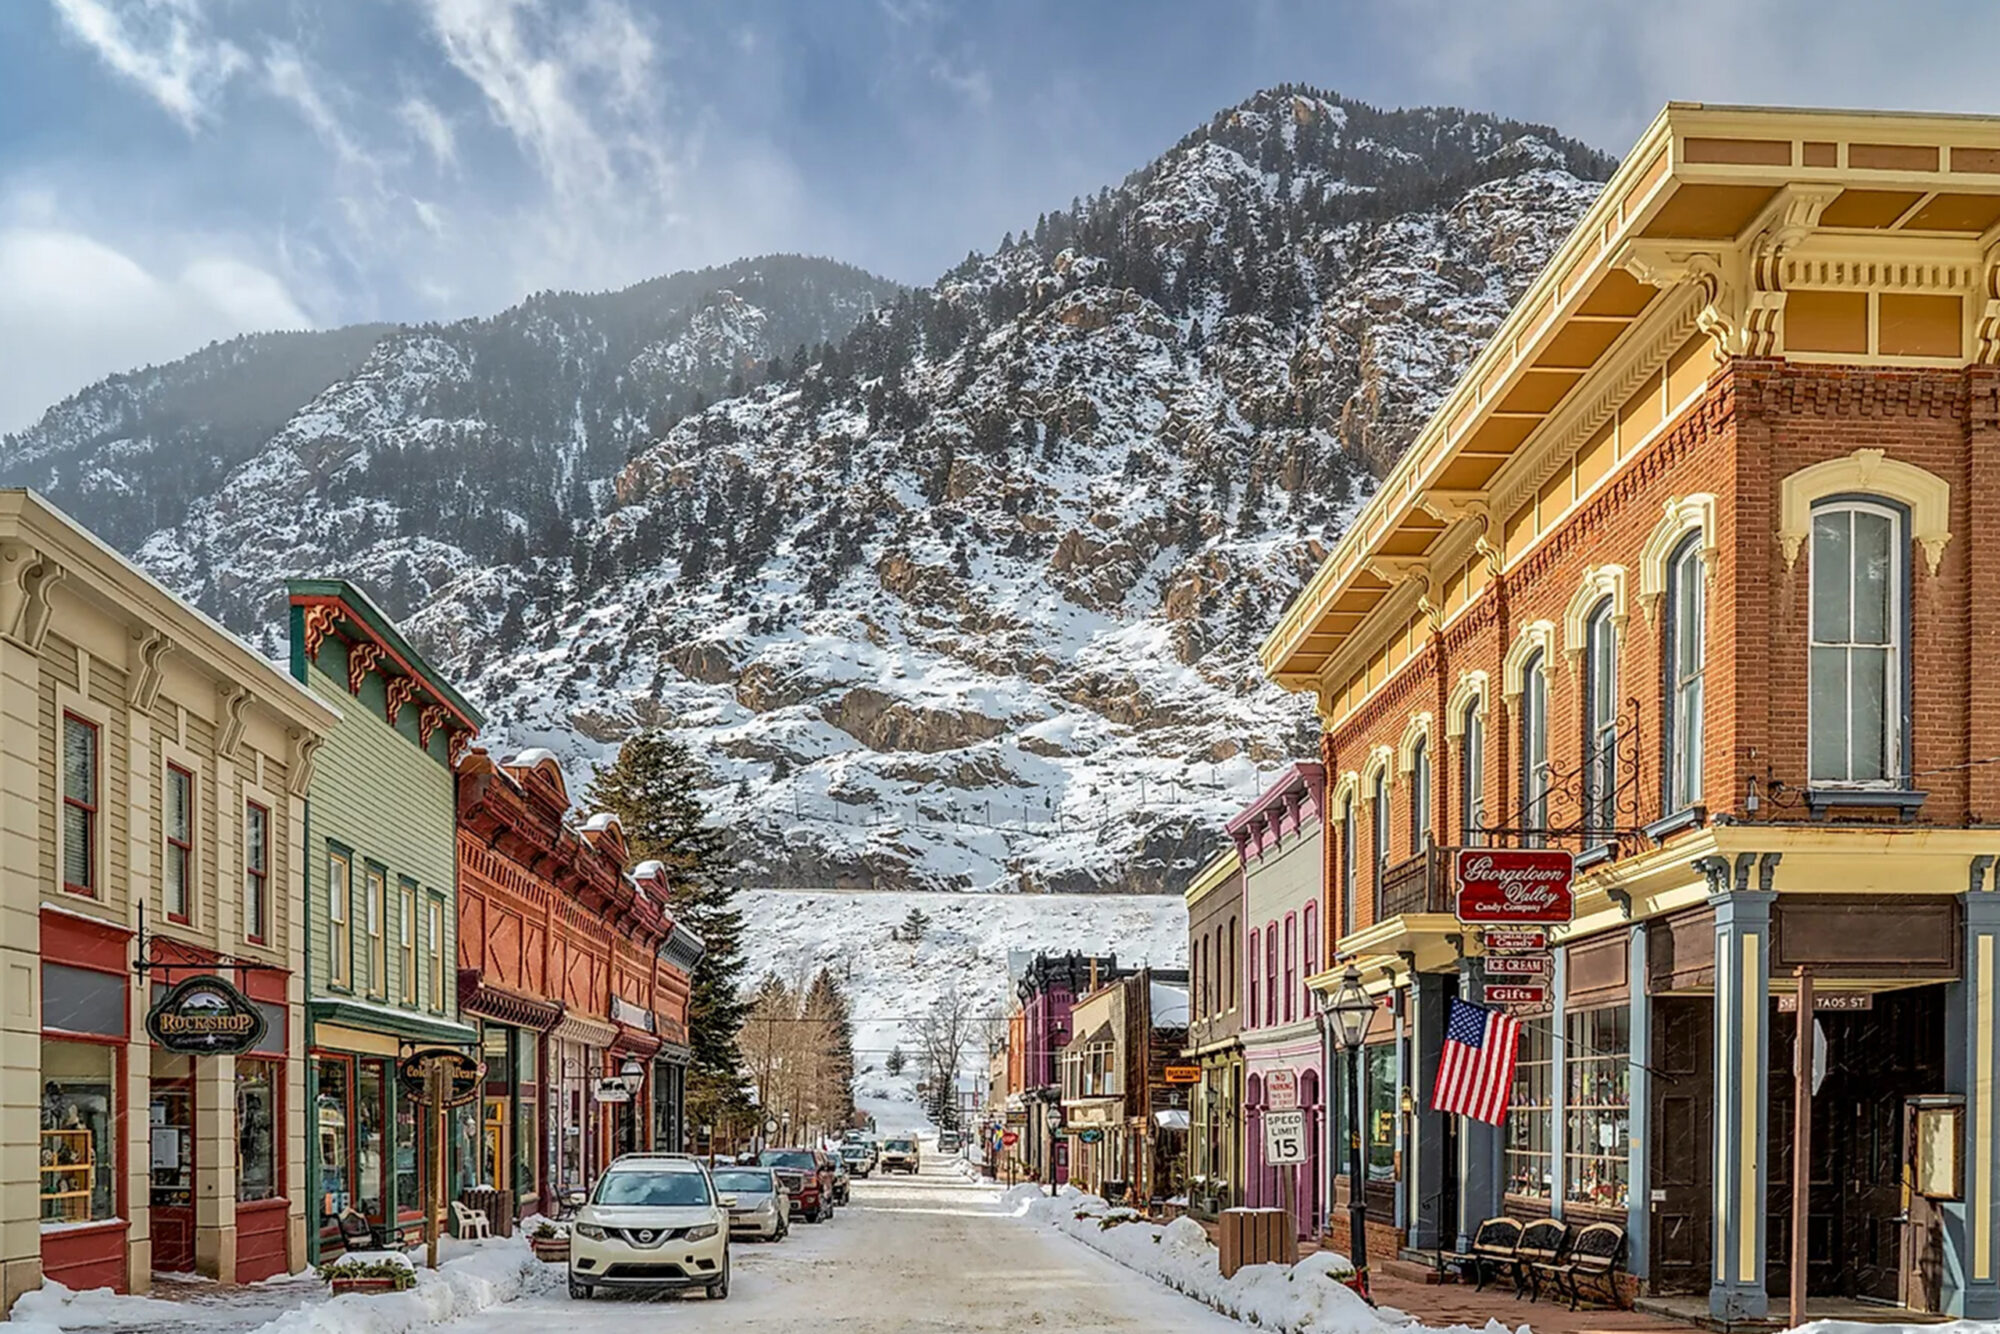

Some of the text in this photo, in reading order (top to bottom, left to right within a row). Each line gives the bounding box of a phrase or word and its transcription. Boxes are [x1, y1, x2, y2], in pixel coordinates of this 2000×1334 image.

[1464, 856, 1565, 890] Georgetown
[1504, 881, 1560, 909] Valley
[1475, 902, 1540, 913] Candy Company
[1496, 938, 1534, 947] Candy
[1489, 960, 1541, 971] ICE CREAM
[1493, 989, 1532, 999] Gifts
[1817, 997, 1865, 1008] TAOS ST
[160, 1013, 254, 1034] ROCK SHOP
[1275, 1073, 1286, 1081] NO
[1267, 1115, 1301, 1125] SPEED
[1271, 1127, 1298, 1136] LIMIT
[1274, 1138, 1298, 1158] 15
